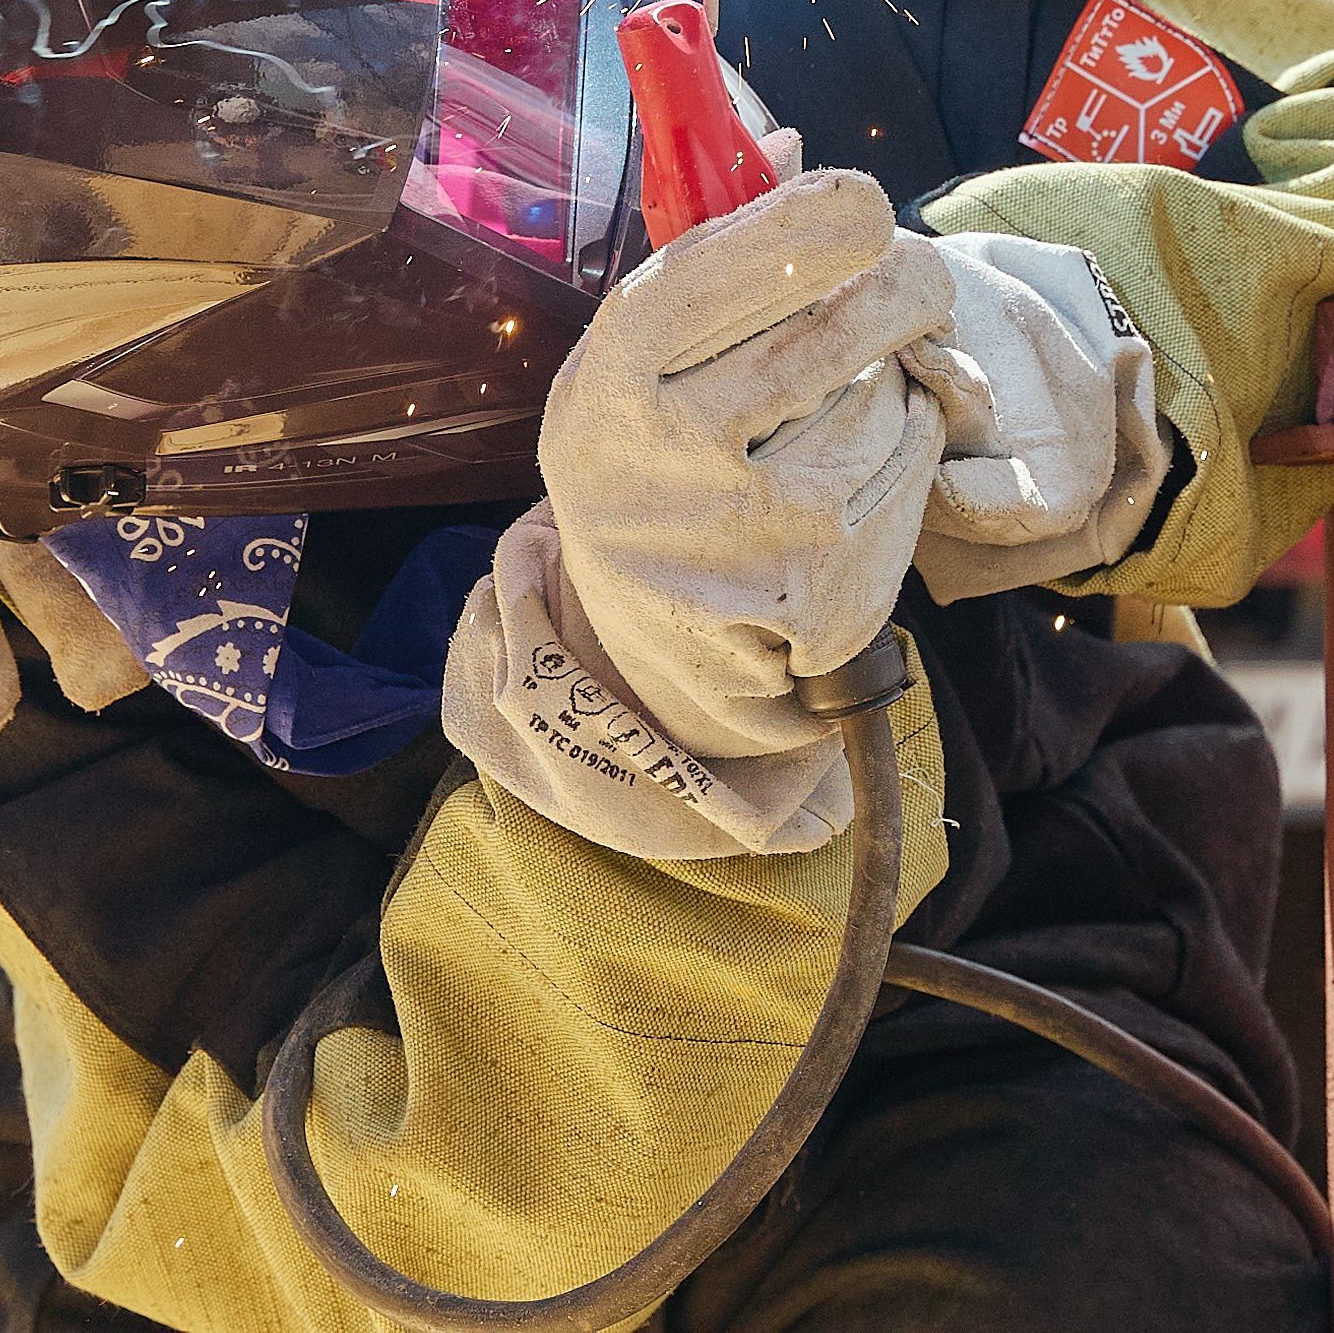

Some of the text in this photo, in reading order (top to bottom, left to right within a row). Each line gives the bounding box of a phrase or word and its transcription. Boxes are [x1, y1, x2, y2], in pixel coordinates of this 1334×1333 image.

[223, 464, 259, 474] IR
[371, 451, 397, 462] M
[568, 744, 636, 787] 019/2011
